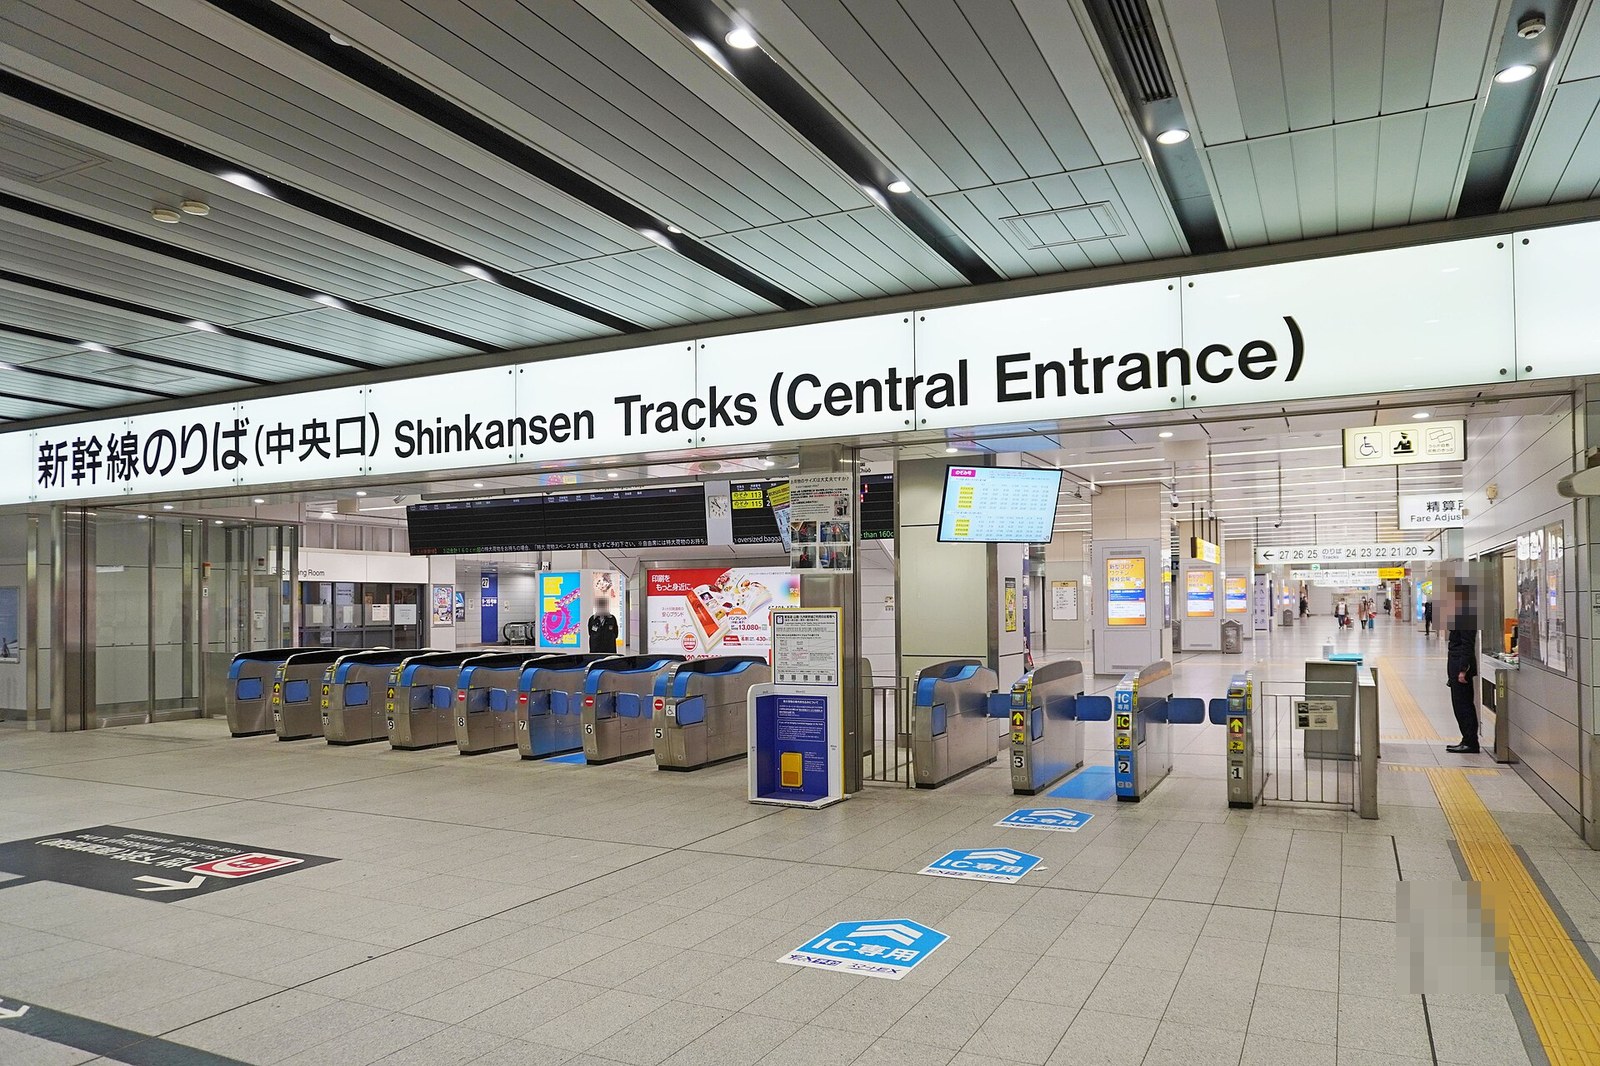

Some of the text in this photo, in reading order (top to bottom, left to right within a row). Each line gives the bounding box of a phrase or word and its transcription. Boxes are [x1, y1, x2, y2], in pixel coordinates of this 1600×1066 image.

[394, 409, 594, 459] Shinkansen
[614, 385, 758, 436] Tracks
[769, 359, 968, 426] (Central
[997, 316, 1305, 403] Entrance)
[1410, 514, 1431, 522] Fare
[864, 530, 877, 538] than
[1279, 550, 1290, 560] 27
[1293, 550, 1304, 560] 26
[1307, 550, 1318, 559] 25
[1346, 548, 1357, 558] 24
[1361, 548, 1372, 558] 23
[1376, 548, 1387, 557] 22
[1391, 547, 1401, 556] 21
[1406, 546, 1418, 556] 20
[652, 574, 670, 582] 印刷を
[1118, 694, 1129, 704] IC
[388, 721, 394, 730] 9
[458, 718, 464, 727] 8
[520, 721, 526, 730] 7
[1117, 716, 1130, 728] IC
[586, 724, 592, 734] 6
[656, 728, 662, 739] 5
[1014, 756, 1024, 768] 3
[1120, 762, 1129, 774] 2
[1234, 768, 1242, 780] 1
[940, 860, 1023, 874] IC専用
[812, 938, 921, 962] IC専用
